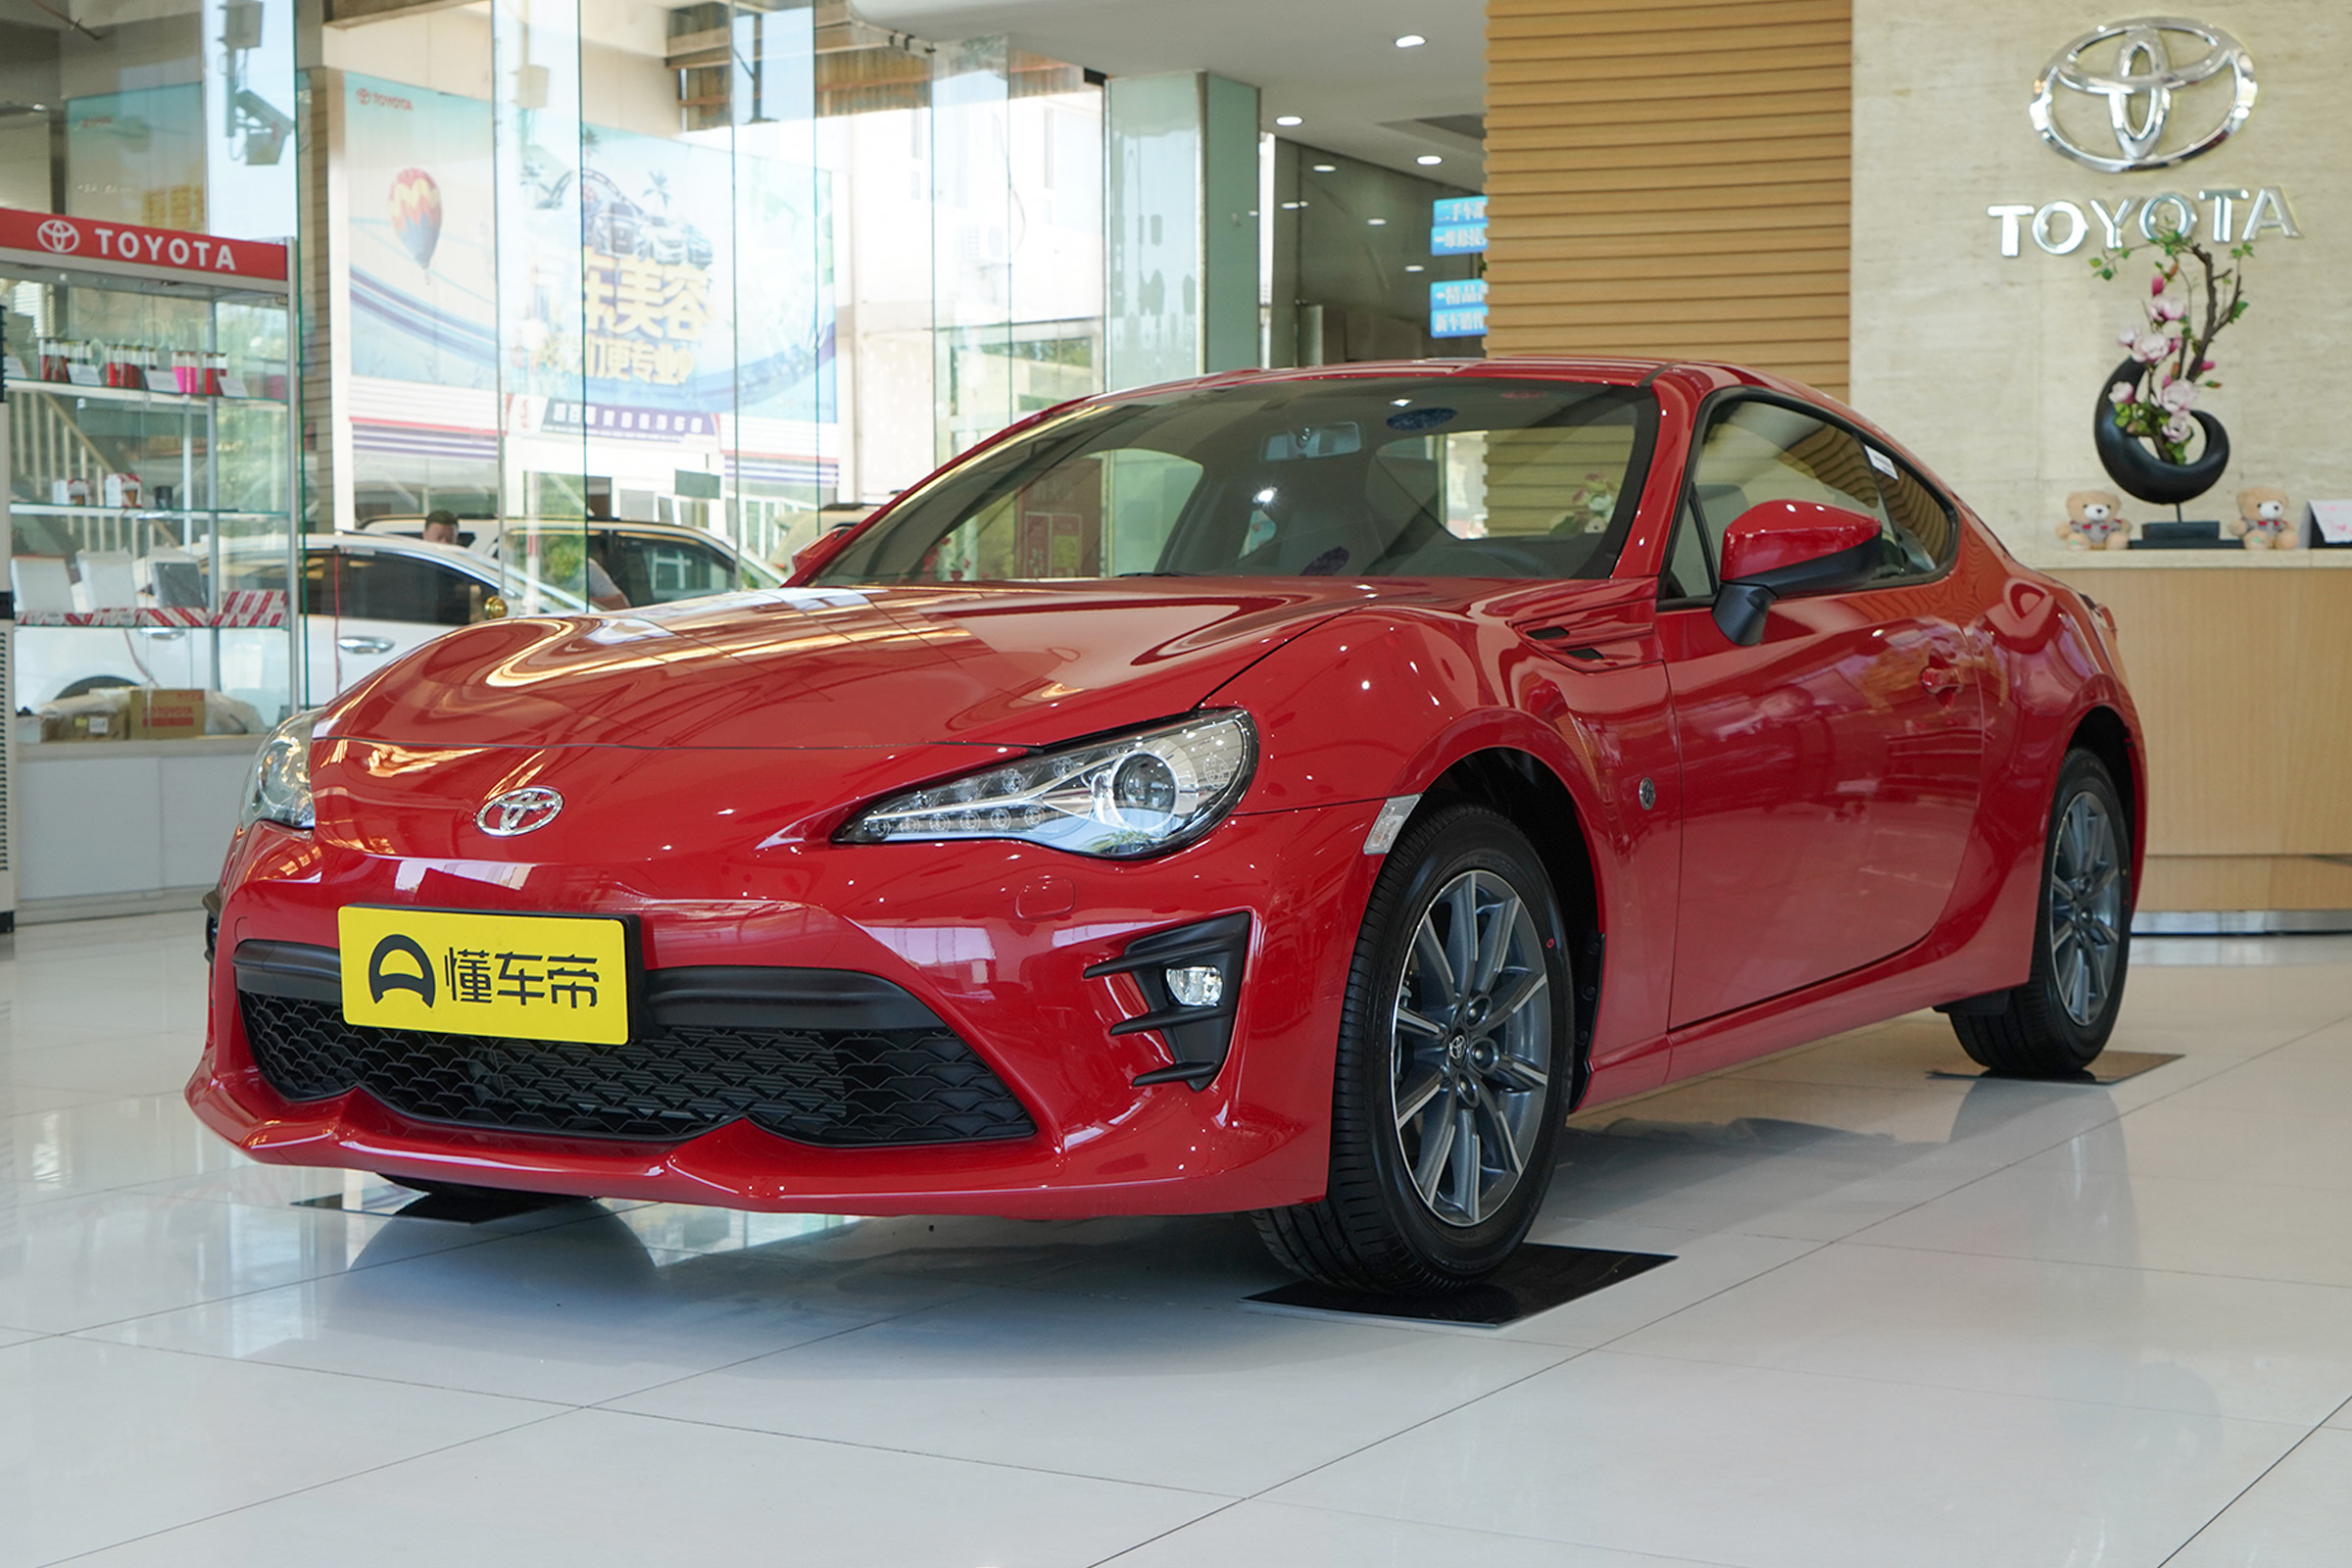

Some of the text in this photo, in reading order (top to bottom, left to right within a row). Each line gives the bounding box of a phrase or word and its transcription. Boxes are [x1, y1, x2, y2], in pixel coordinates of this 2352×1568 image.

[94, 227, 236, 271] TOYOTA
[1986, 185, 2301, 257] TOYOTA
[444, 946, 600, 1009] 懂车帝
